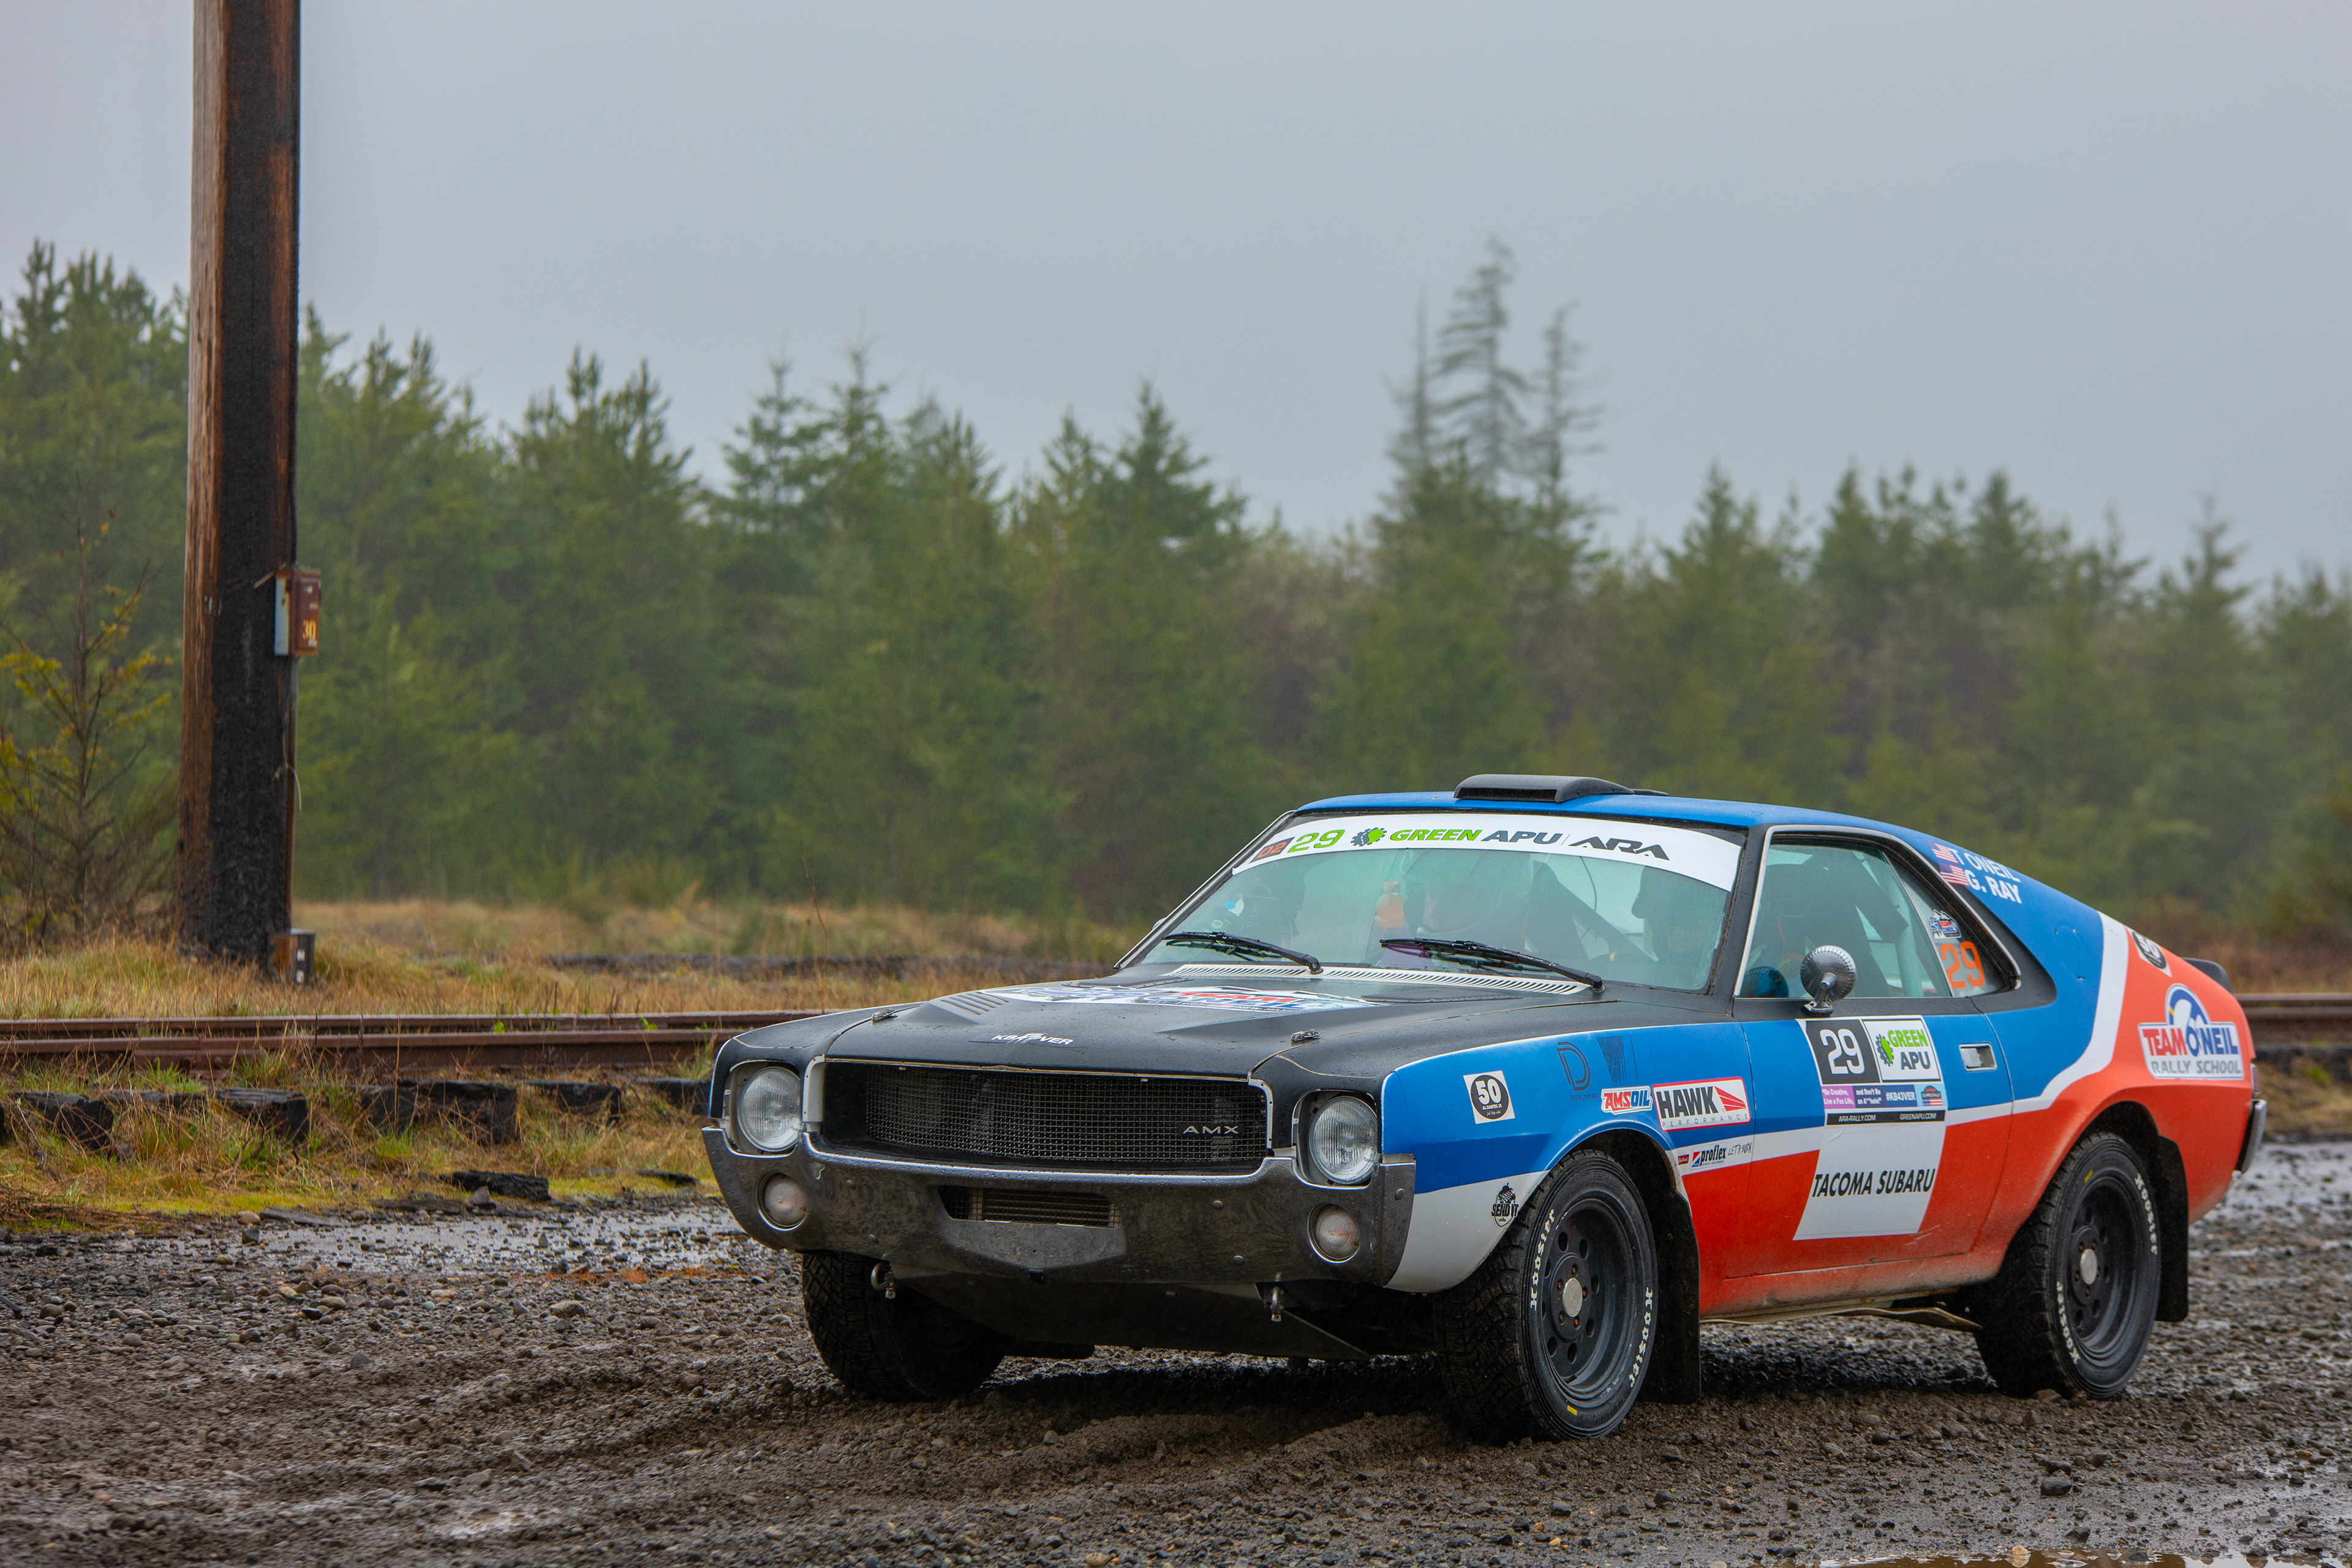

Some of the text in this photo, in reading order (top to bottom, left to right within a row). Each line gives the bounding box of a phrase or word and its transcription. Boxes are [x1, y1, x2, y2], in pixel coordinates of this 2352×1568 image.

[1257, 829, 1670, 861] 02 29 GREEN APU ARA
[1964, 852, 2021, 883] ONEIL
[1964, 869, 2022, 904] G. RAY
[1940, 941, 1985, 989] 29
[1177, 992, 1304, 1003] TEAM
[1888, 1030, 1929, 1048] GREEN
[2141, 1028, 2188, 1056] TEAM
[1820, 1028, 1865, 1075] 29
[1901, 1051, 1931, 1070] APU
[2150, 1060, 2241, 1074] RALLY SCHOOL
[1475, 1079, 1501, 1105] 50
[1604, 1090, 1650, 1111] AMSOIL
[1656, 1087, 1719, 1119] HAWK
[1886, 1091, 1917, 1101] #KB43VER
[1183, 1126, 1239, 1134] AMX
[1662, 1114, 1748, 1127] PERFORMANCE
[1700, 1144, 1727, 1166] proflex
[1812, 1169, 1936, 1197] TACOMA SUBARU
[1491, 1204, 1519, 1217] SEND IT
